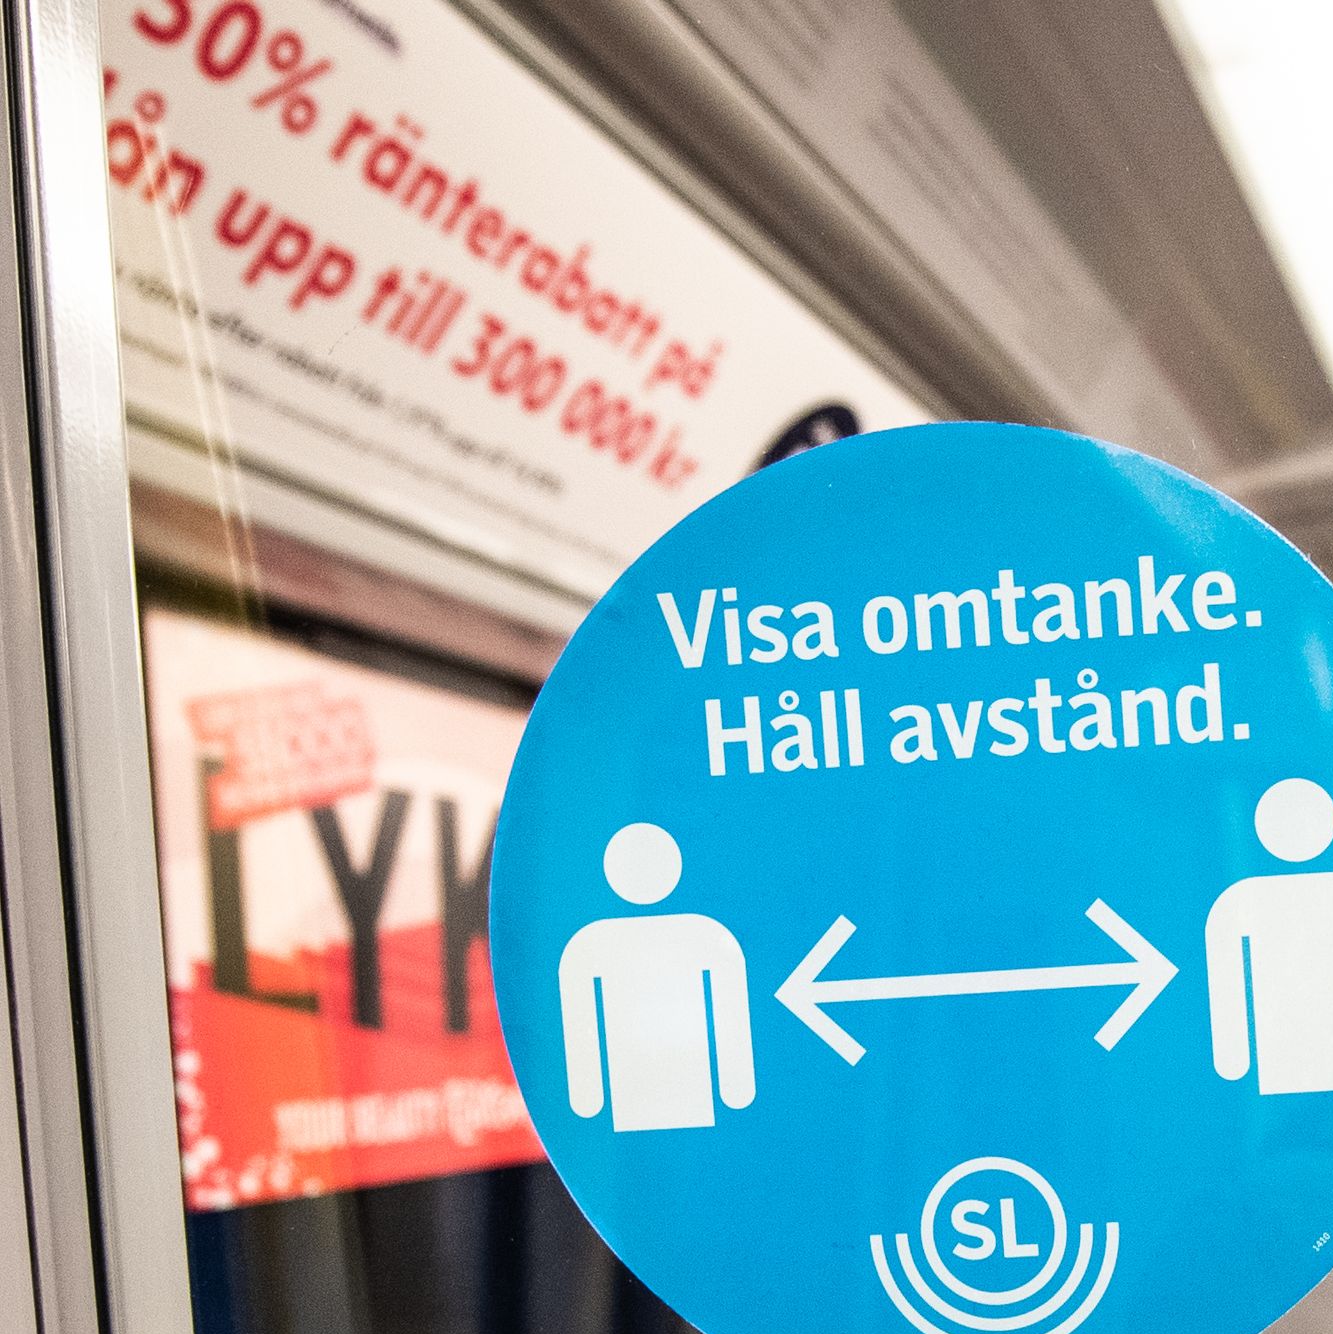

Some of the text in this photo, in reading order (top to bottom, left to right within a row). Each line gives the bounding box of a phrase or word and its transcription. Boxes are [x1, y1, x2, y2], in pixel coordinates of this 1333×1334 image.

[103, 66, 207, 218] ån
[213, 188, 358, 312] upp
[361, 266, 468, 356] till
[450, 312, 567, 414] 300
[560, 378, 657, 467] 000
[645, 422, 699, 490] kr
[329, 111, 660, 362] ränterabatt
[640, 338, 723, 400] på
[656, 555, 1262, 668] Visa omtanke.
[704, 663, 1250, 776] Håll avstånd.
[951, 1198, 1039, 1260] SL
